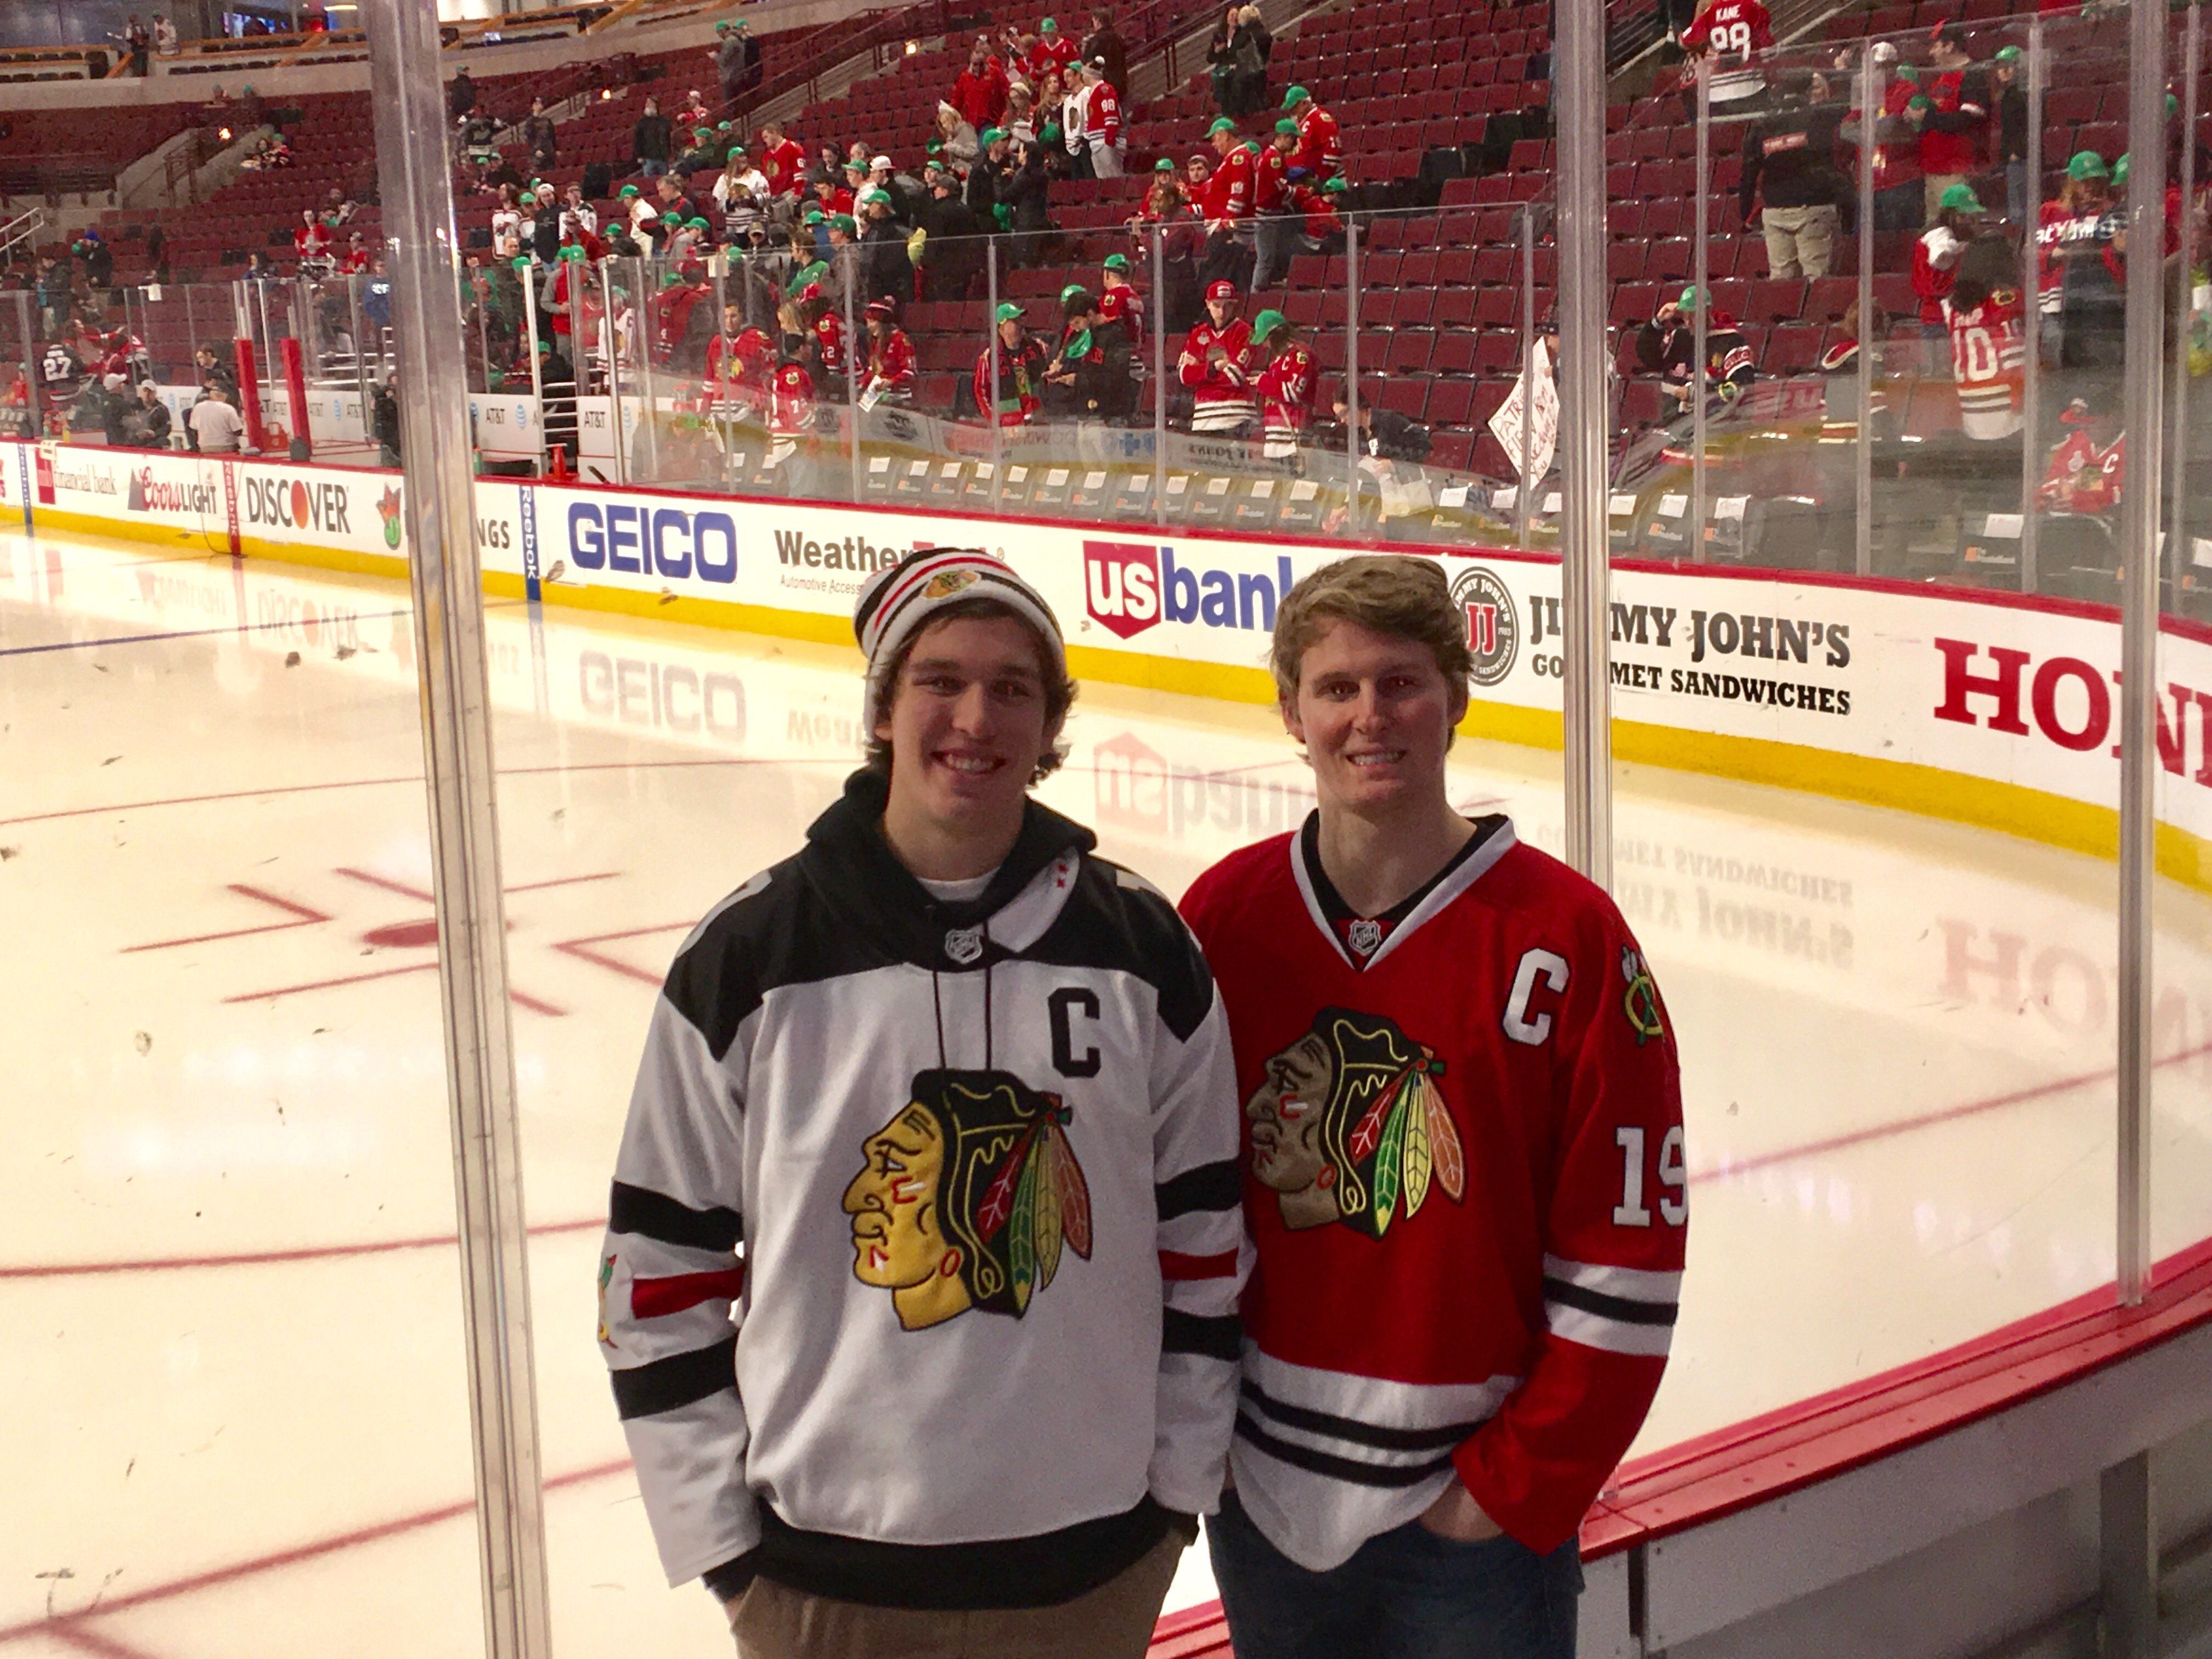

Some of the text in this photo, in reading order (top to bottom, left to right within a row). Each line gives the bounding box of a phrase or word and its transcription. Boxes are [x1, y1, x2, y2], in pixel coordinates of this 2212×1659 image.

[1716, 4, 1741, 21] KANE
[43, 356, 72, 382] 27
[486, 408, 505, 425] AT&T
[584, 411, 606, 428] AT&T
[139, 466, 217, 515] Coors LIGHT
[2103, 453, 2119, 473] C
[246, 476, 351, 534] DISCOVER
[522, 486, 538, 579] Reebok
[476, 518, 510, 550] NGS
[568, 501, 738, 584] GEICO
[828, 579, 862, 595] Access
[1465, 601, 1497, 656] JJ
[1529, 595, 1850, 669] JIMY JOHN'S
[1532, 653, 1851, 716] GOMET SANDWICHES
[1502, 948, 1570, 1046] C
[1048, 987, 1102, 1079] C
[1613, 1125, 1689, 1227] 19
